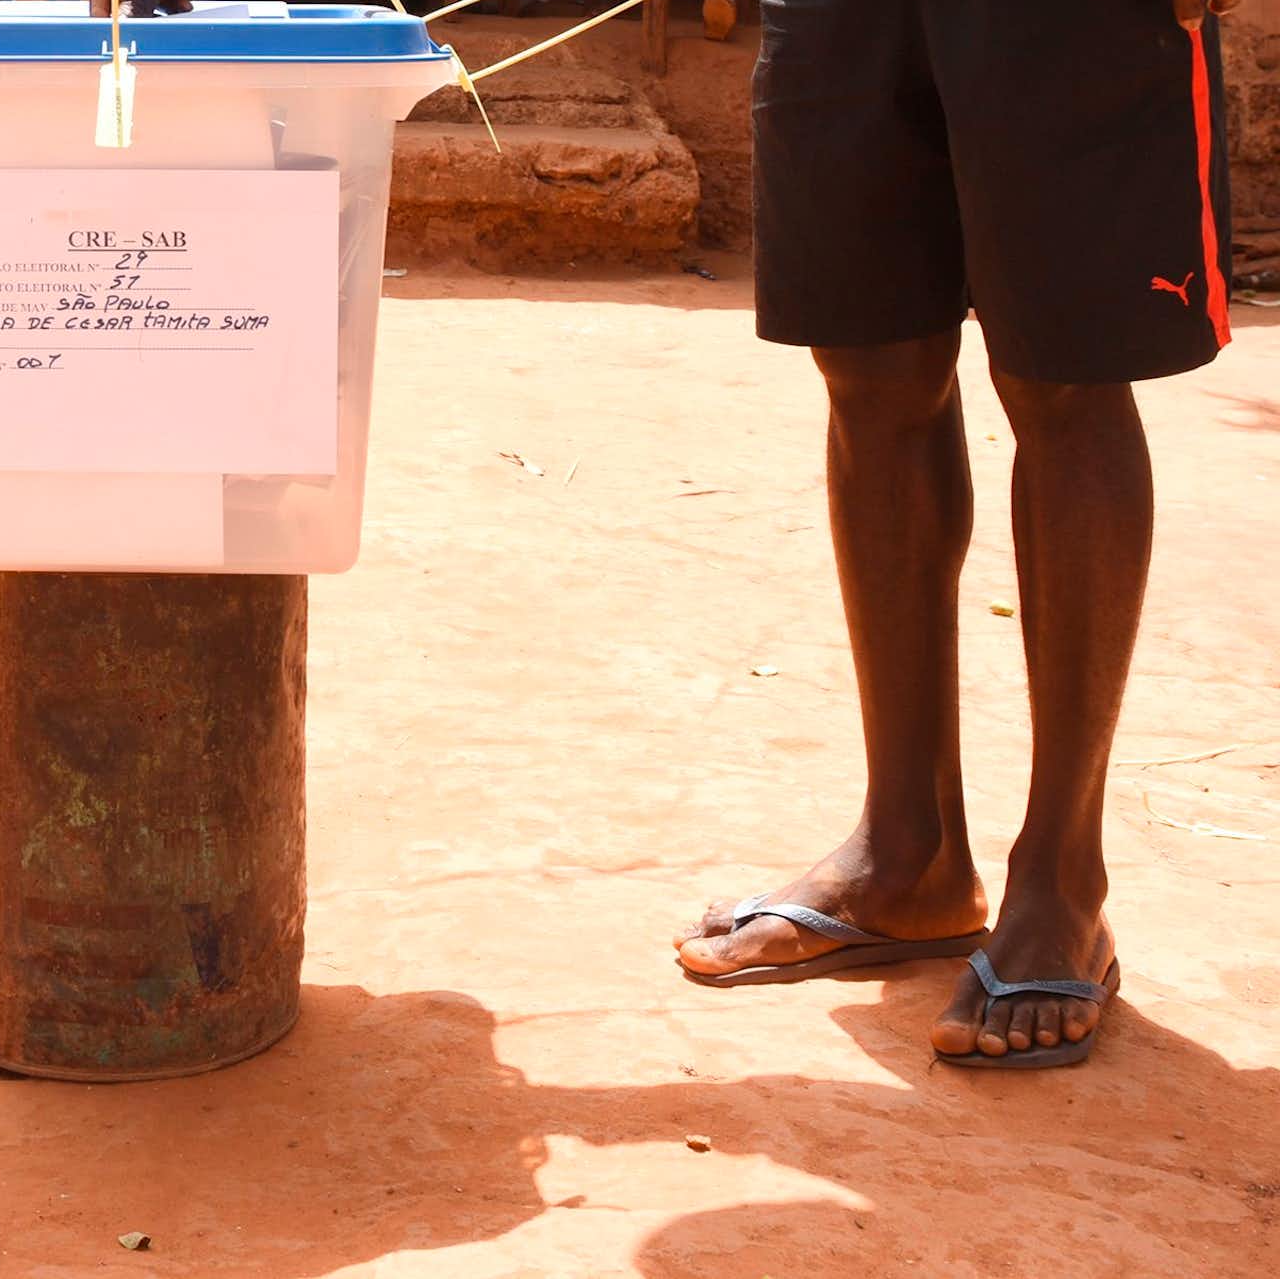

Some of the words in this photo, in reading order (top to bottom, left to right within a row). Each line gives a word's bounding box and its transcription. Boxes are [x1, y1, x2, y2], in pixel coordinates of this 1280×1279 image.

[68, 230, 117, 248] CRE
[141, 230, 188, 248] SAB
[15, 261, 85, 273] ELEITORAL
[17, 282, 87, 294] ELEITORAL
[1, 303, 18, 312] DE
[27, 317, 55, 330] DE
